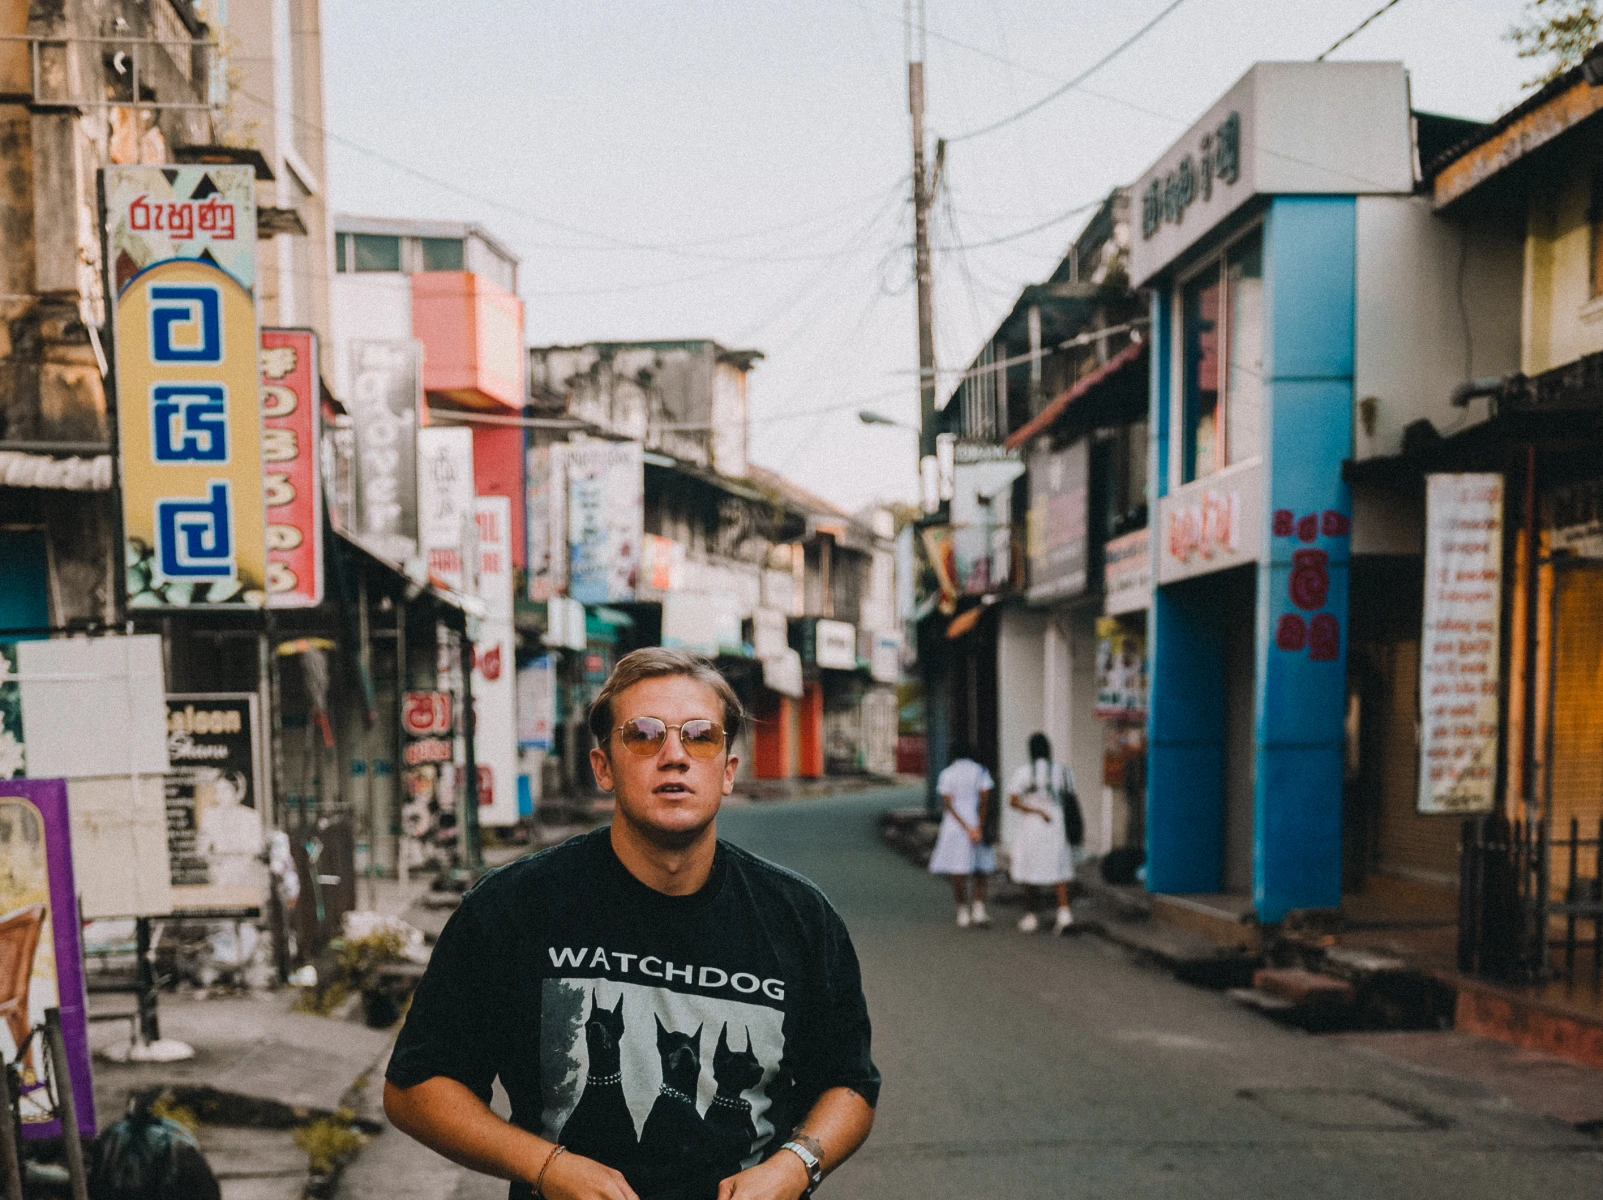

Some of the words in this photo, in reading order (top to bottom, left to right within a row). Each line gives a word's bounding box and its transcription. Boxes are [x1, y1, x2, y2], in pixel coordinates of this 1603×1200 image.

[129, 194, 235, 240] රුහුණු
[168, 705, 242, 734] aloon
[548, 947, 785, 1001] WATCHDOG
